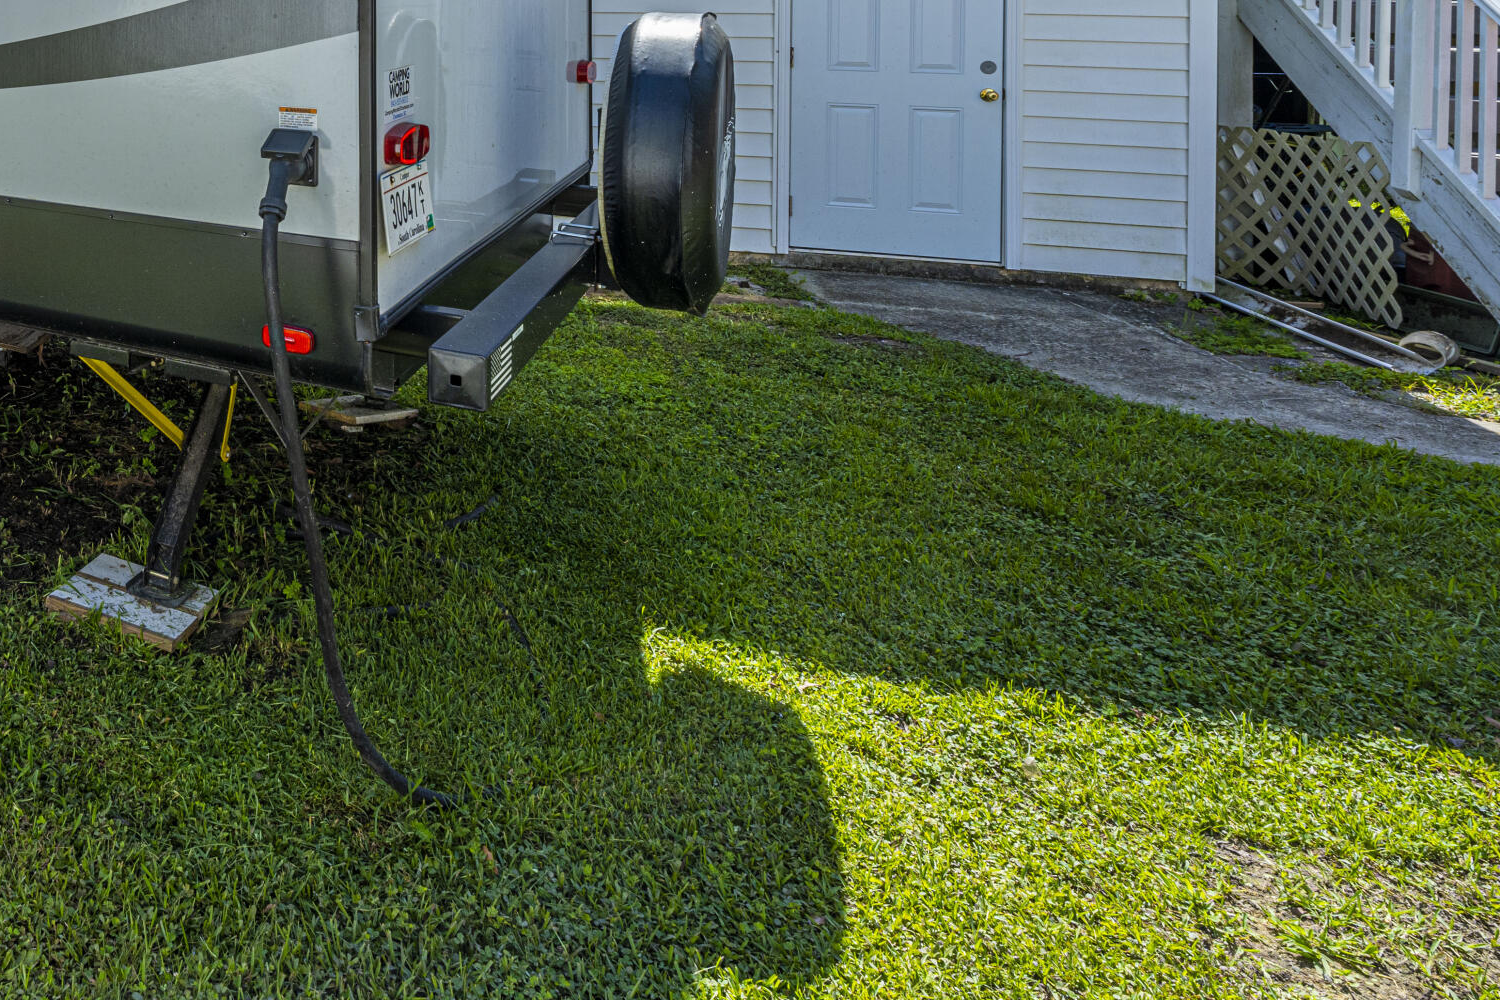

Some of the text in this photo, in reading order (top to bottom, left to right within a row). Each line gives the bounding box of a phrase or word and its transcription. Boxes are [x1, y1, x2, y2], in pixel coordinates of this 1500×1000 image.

[388, 67, 410, 83] CAMPING
[389, 80, 410, 99] WORLD
[390, 183, 418, 230] 30647
[398, 223, 425, 242] South Carolina
